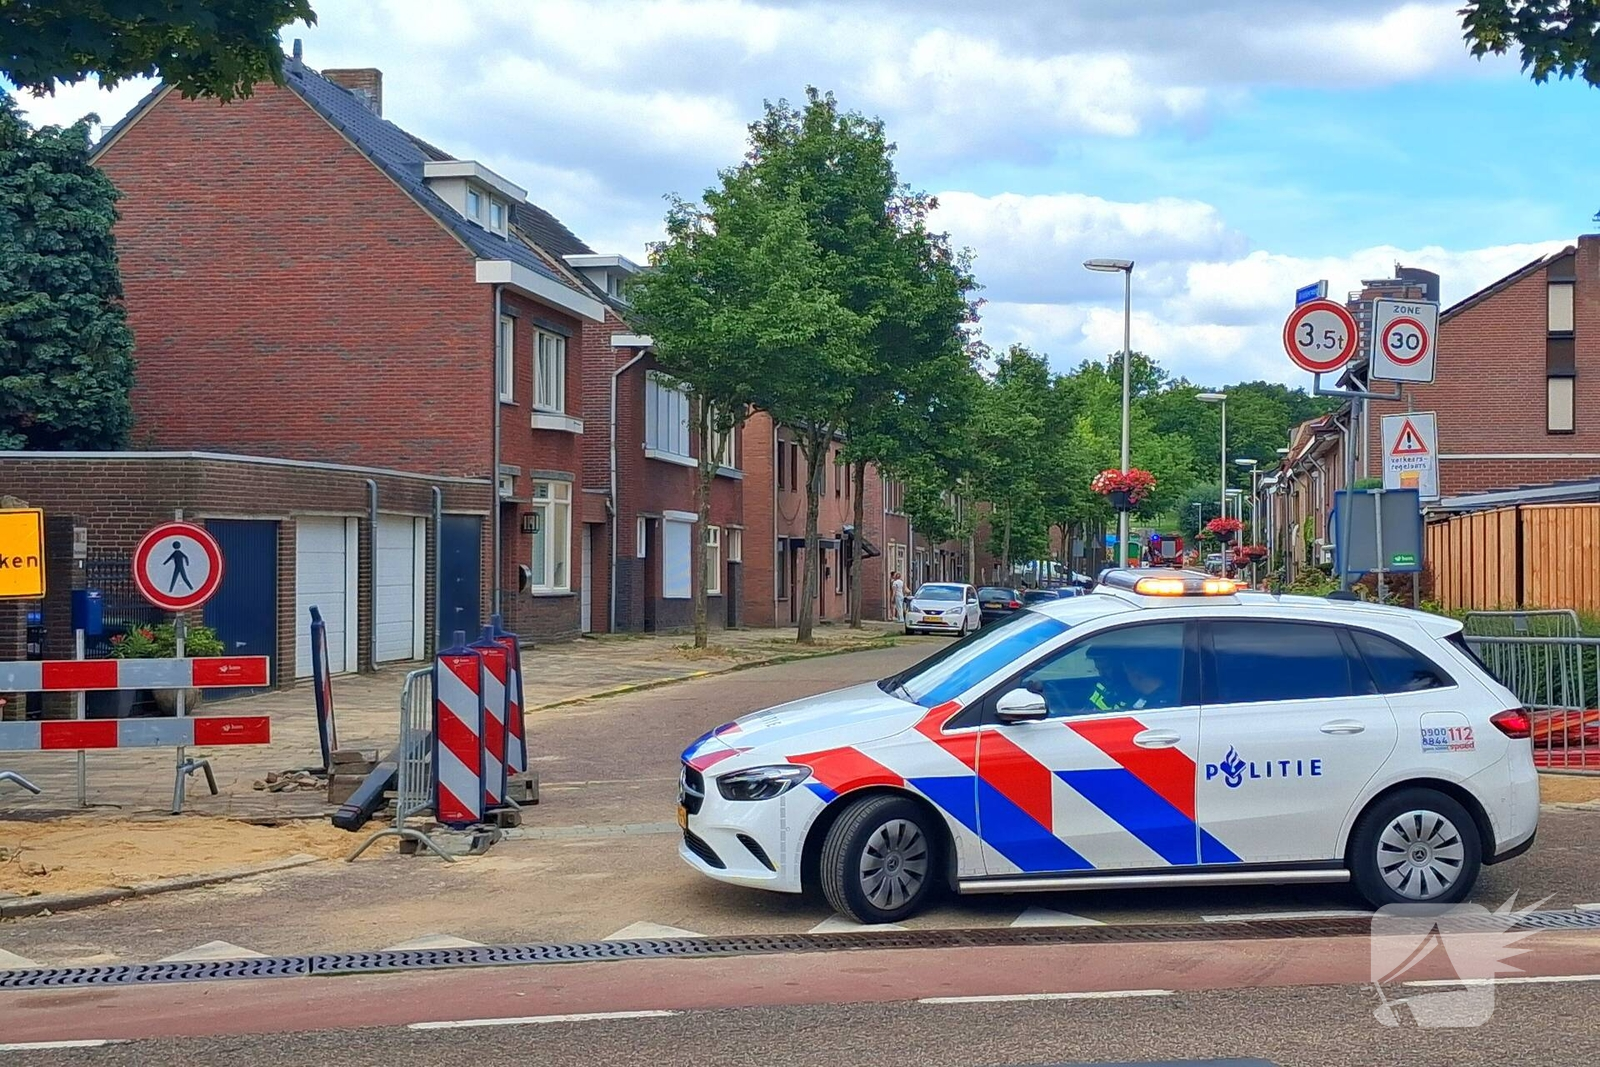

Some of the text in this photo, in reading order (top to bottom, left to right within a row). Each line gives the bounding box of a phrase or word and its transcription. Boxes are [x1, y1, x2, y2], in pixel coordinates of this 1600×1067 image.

[1392, 305, 1422, 315] ZONE
[1390, 332, 1420, 351] 30
[1448, 727, 1474, 741] 112
[1422, 737, 1448, 746] 8844
[1205, 757, 1323, 787] POLITIE
